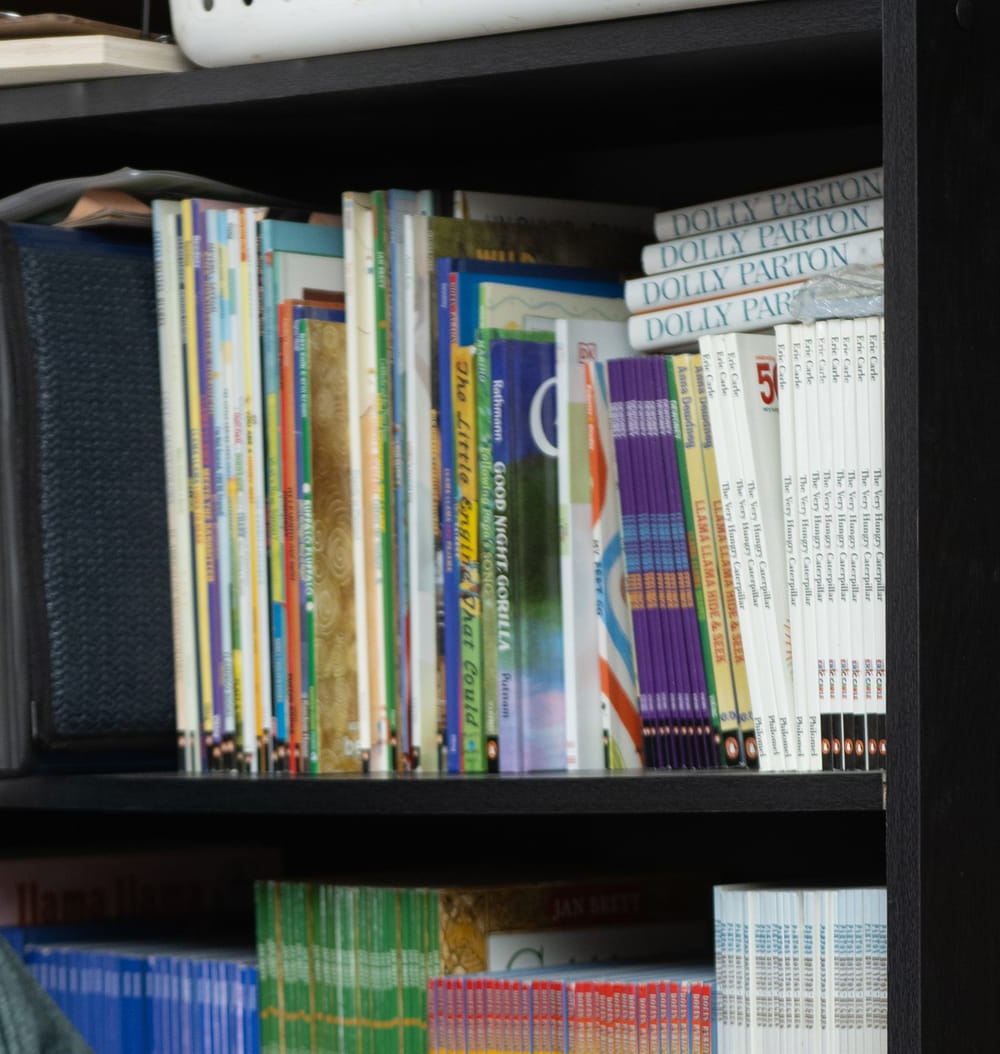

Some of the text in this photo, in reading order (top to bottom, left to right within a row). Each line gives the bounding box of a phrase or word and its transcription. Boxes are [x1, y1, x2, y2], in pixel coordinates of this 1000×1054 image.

[671, 195, 762, 237] DOLLY
[771, 172, 882, 216] PARTON
[660, 204, 870, 268] DOLLY PARTON
[643, 243, 851, 305] DOLLY PARTON
[646, 300, 735, 341] DOLLY
[716, 351, 728, 396] Eric Carle
[727, 352, 740, 398] Eric Carle
[793, 343, 801, 362] Eric
[805, 339, 814, 384] Eric Carle
[831, 337, 840, 383] Eric Carle
[843, 359, 851, 383] Carle
[857, 336, 865, 382] Eric Carle
[870, 356, 878, 381] Carle
[678, 366, 689, 394] Anna
[703, 354, 715, 399] Eric Carle
[493, 380, 504, 442] Rathmann
[481, 448, 491, 504] Following
[494, 462, 506, 510] GOOD
[799, 495, 808, 515] Very
[846, 492, 856, 512] Very
[456, 362, 479, 726] The Little Engine That Could
[721, 481, 746, 610] The Very Hungry Caterpillar
[735, 479, 759, 608] The Very Hungry Caterpillar
[747, 481, 771, 609] The Very Hungry Caterpillar
[783, 476, 798, 607] The Very Hungry Caterpillar
[801, 518, 810, 554] Hungry
[811, 472, 824, 602] The Very Hungry Caterpillar
[822, 472, 835, 602] The Very Hungry Caterpillar
[836, 471, 847, 602] The Very Hungry Caterpillar
[848, 515, 857, 550] Hungry
[860, 470, 872, 602] The Very Hungry Caterpillar
[873, 470, 883, 602] The Very Hungry Caterpillar
[483, 552, 494, 593] SONG
[696, 500, 727, 664] LLAMA LLAMA HIDE & SEEK
[713, 500, 746, 664] LLAMA LLAMA HIDE & SEEK
[803, 557, 812, 606] Caterpillar
[497, 575, 510, 651] GORILLA
[502, 673, 512, 718] Putnam
[755, 717, 765, 757] Philomel
[768, 715, 779, 755] Philomel
[779, 717, 791, 757] Philomel
[796, 716, 804, 757] Philomel
[809, 716, 817, 757] Philomel
